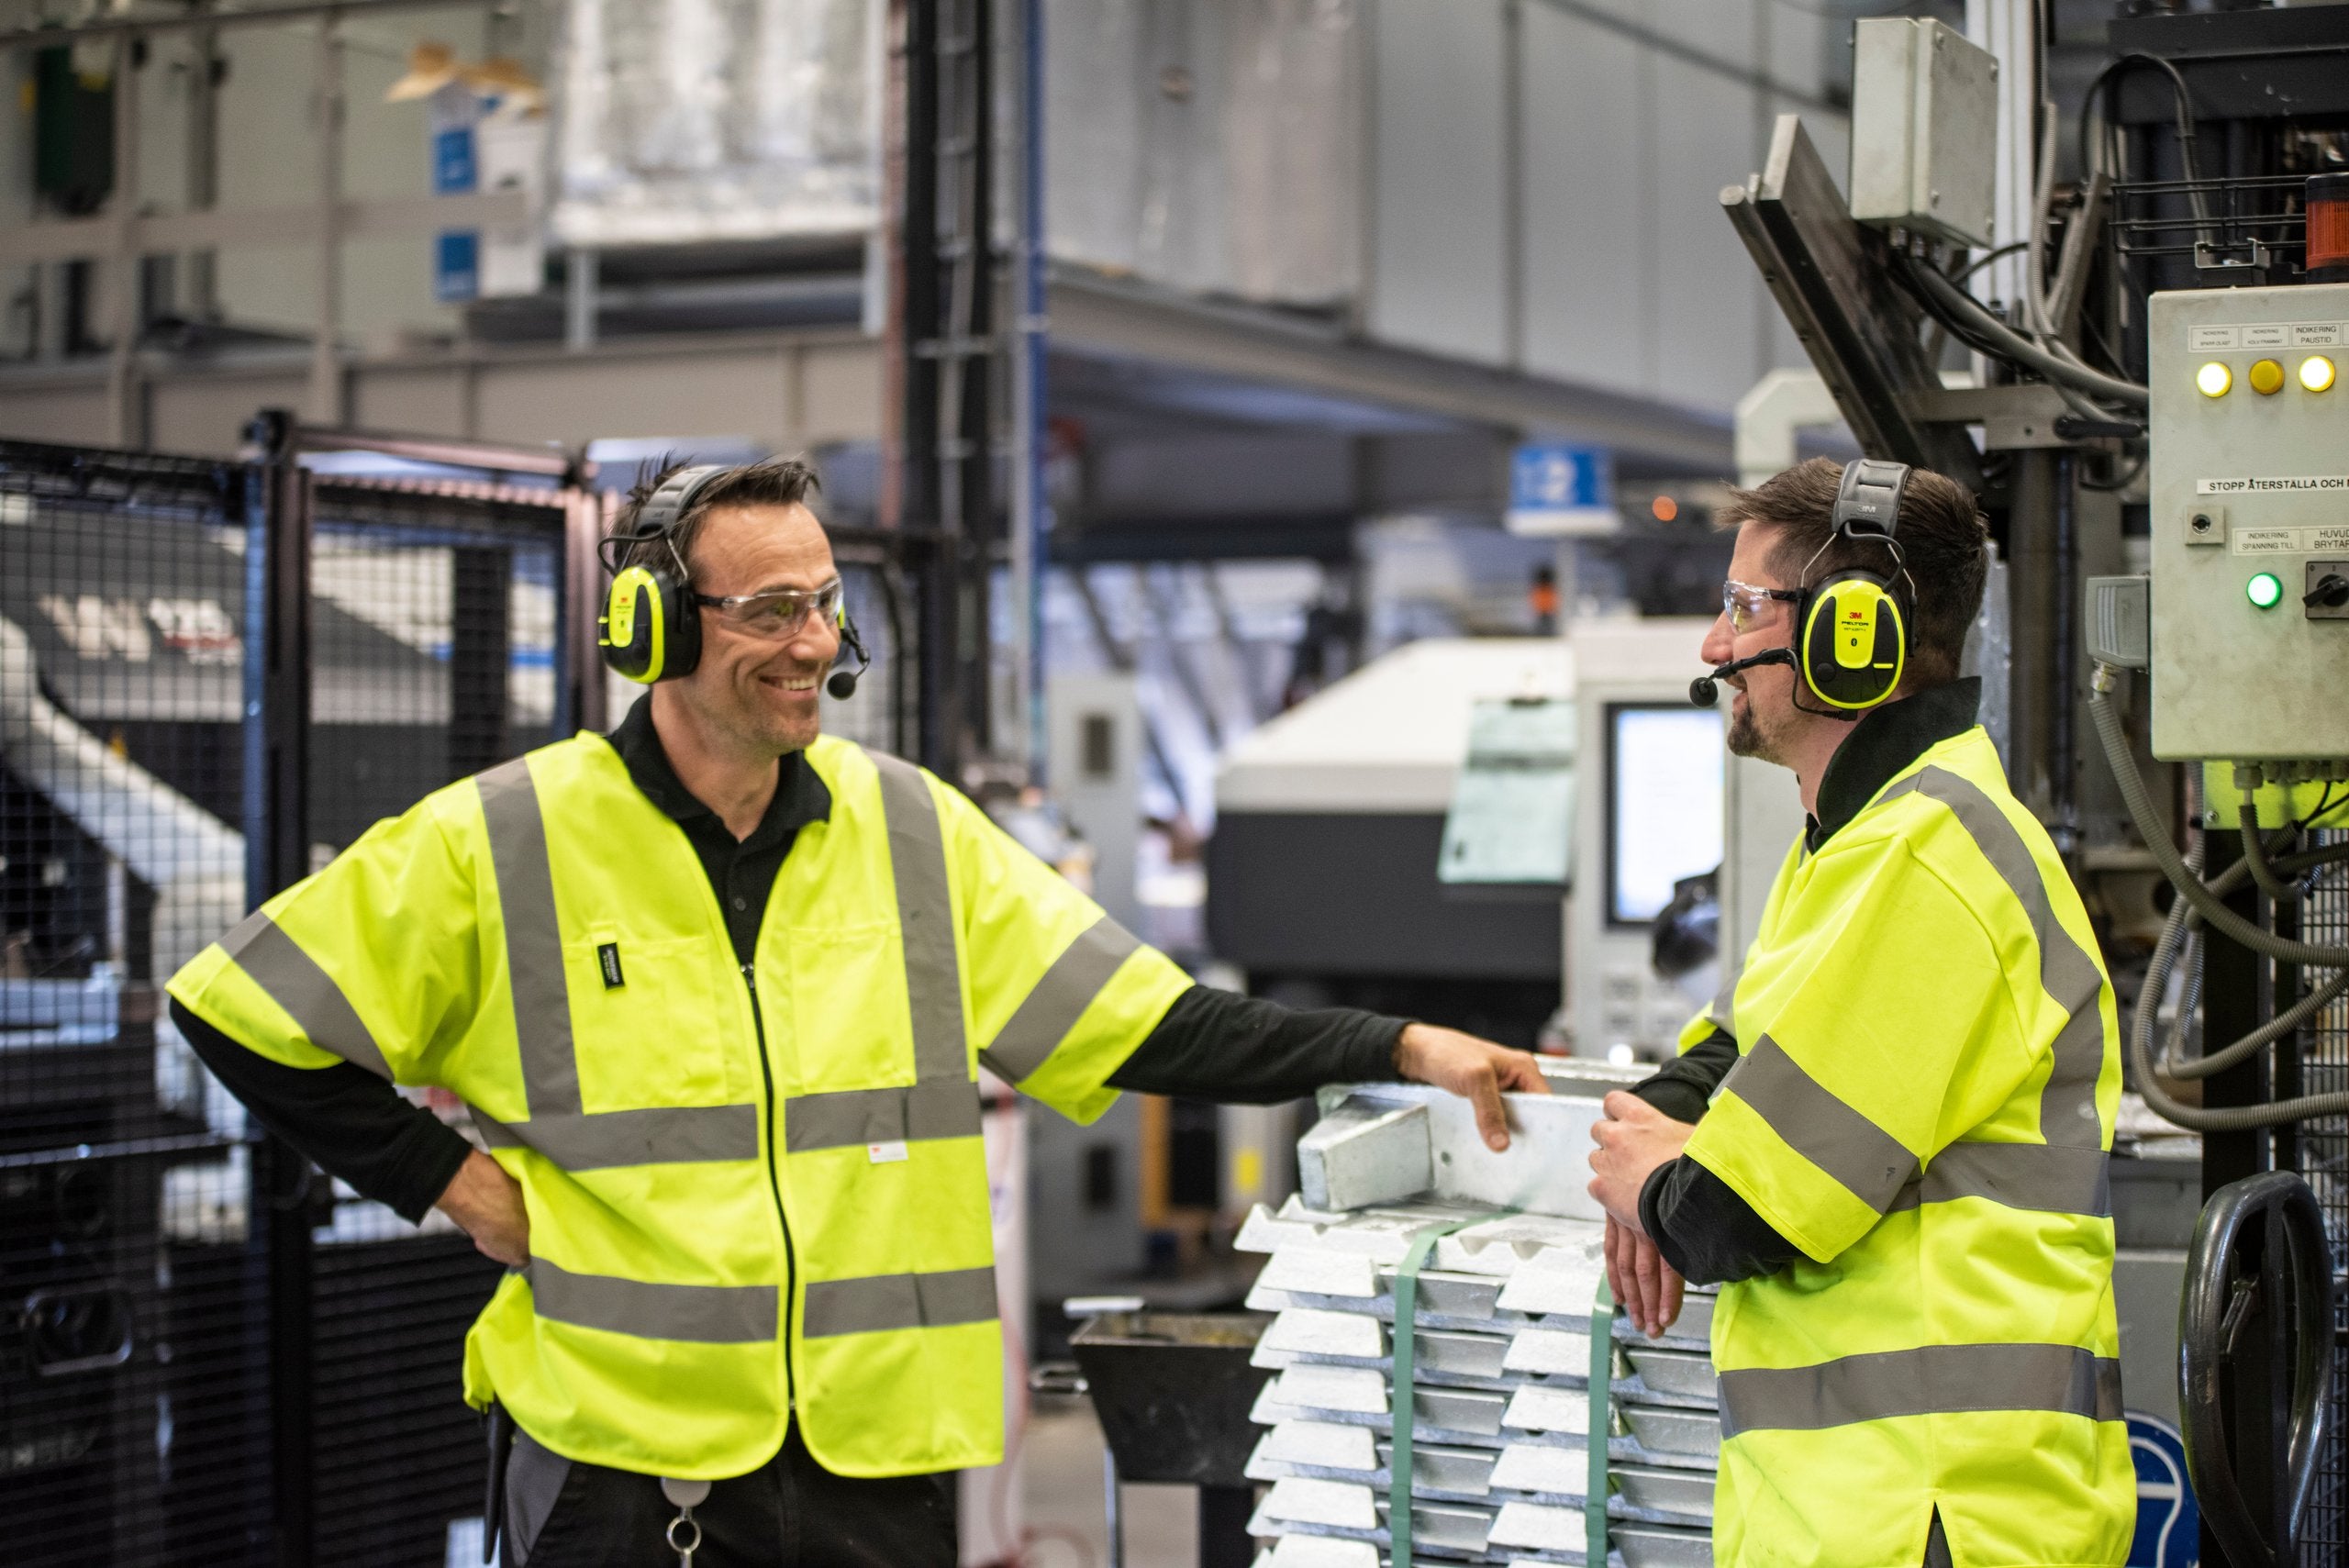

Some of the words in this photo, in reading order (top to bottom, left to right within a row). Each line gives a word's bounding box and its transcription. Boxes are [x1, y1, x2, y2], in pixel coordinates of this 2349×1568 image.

[2295, 326, 2337, 334] INDIKERING
[2300, 336, 2332, 344] PAUSTID
[2209, 481, 2245, 491] STOPP
[2321, 479, 2343, 488] OCH
[2248, 531, 2288, 539] INDIKERING
[1849, 611, 1863, 619] 3M
